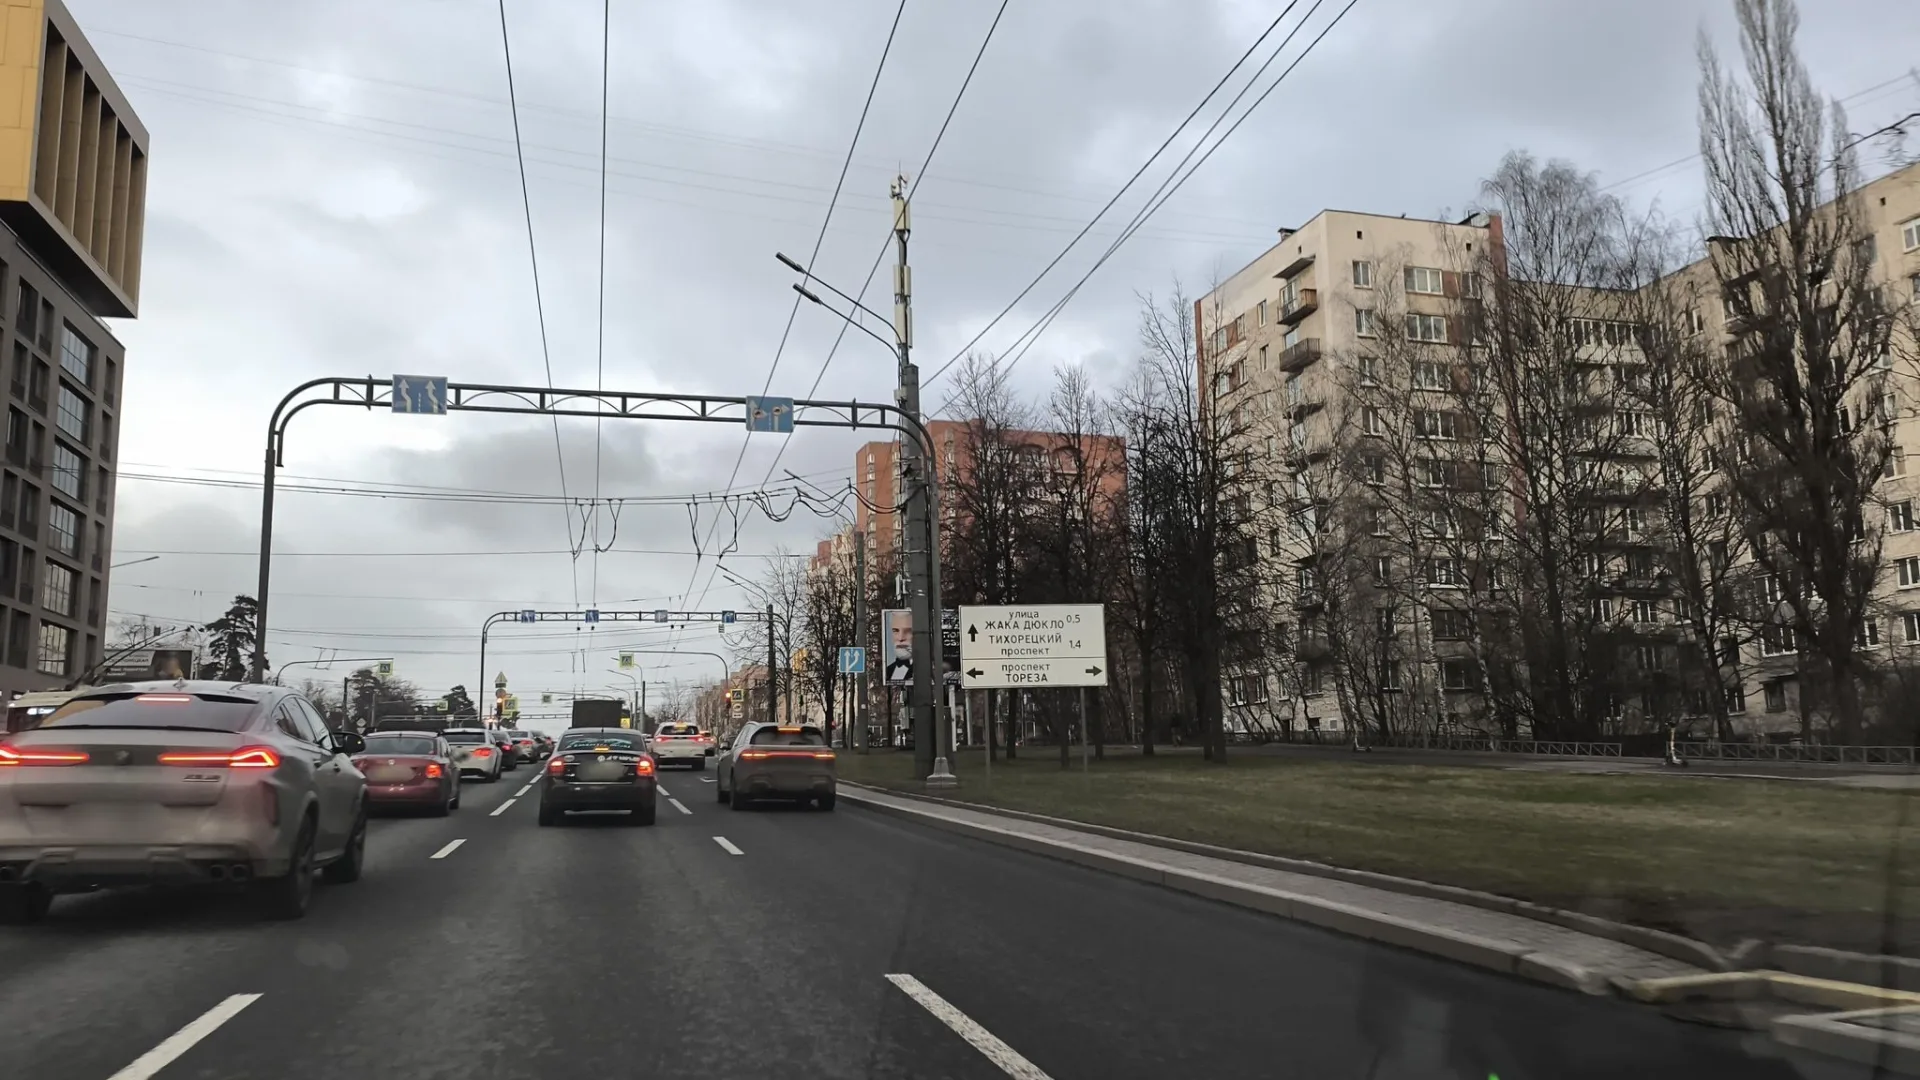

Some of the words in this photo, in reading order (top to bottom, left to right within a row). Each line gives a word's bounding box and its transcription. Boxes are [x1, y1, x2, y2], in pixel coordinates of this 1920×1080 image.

[1009, 611, 1039, 620] улица
[1066, 614, 1081, 623] 0.5
[984, 620, 1020, 630] ЖАКА
[1023, 620, 1064, 630] ДЮКЛО
[989, 633, 1062, 644] ТИХОРЕЦКИЙ
[1069, 640, 1081, 649] 1.4
[1001, 647, 1049, 657] проспект
[1001, 663, 1050, 673] проспект
[1005, 673, 1048, 683] ТОРЕЗА
